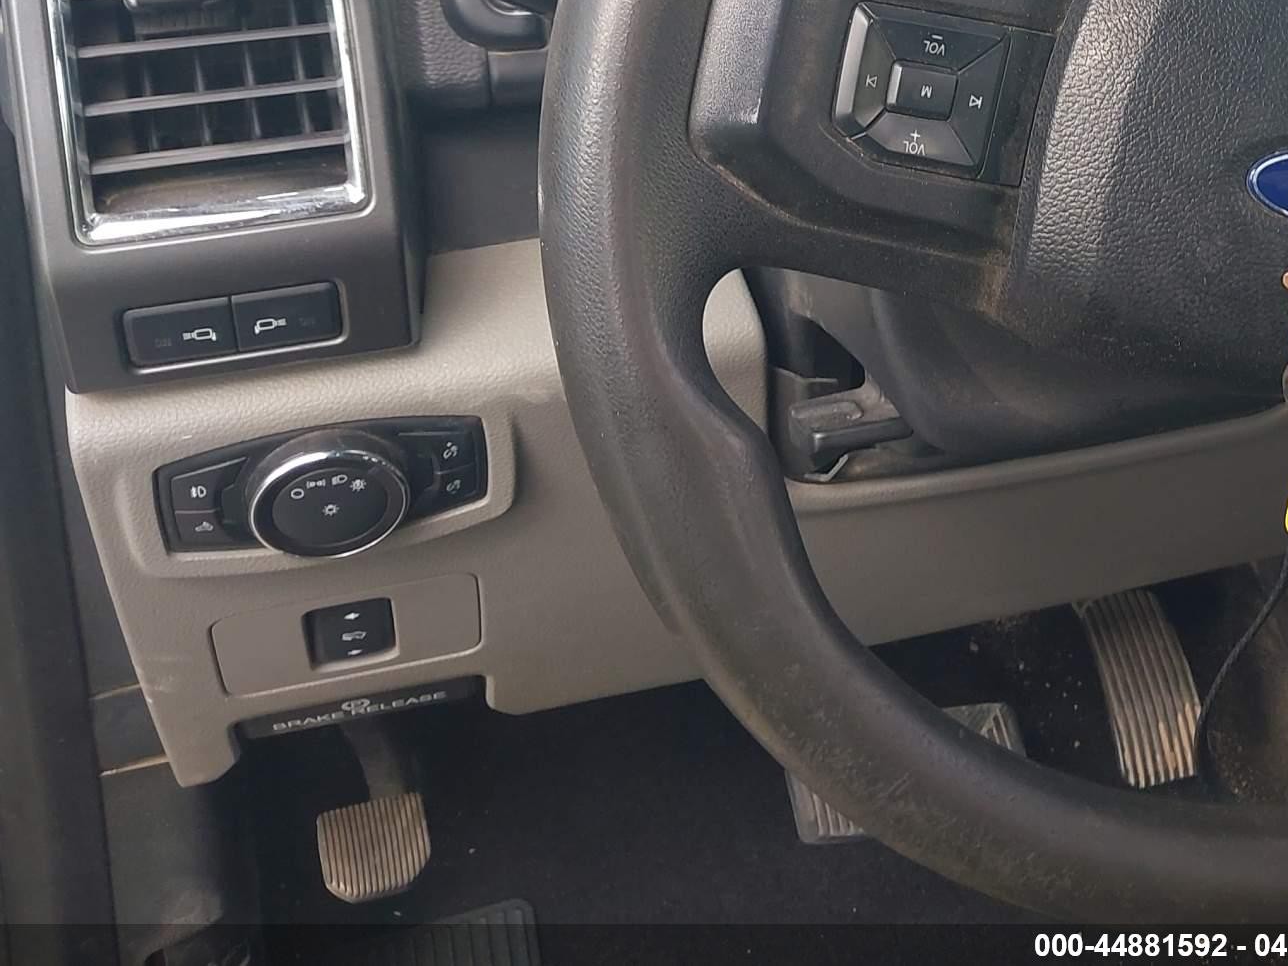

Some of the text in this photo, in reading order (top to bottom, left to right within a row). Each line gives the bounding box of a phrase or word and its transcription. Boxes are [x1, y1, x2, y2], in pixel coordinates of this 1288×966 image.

[923, 40, 945, 56] VOL
[903, 140, 926, 156] VOL
[272, 691, 448, 731] BRAKE RELEASE
